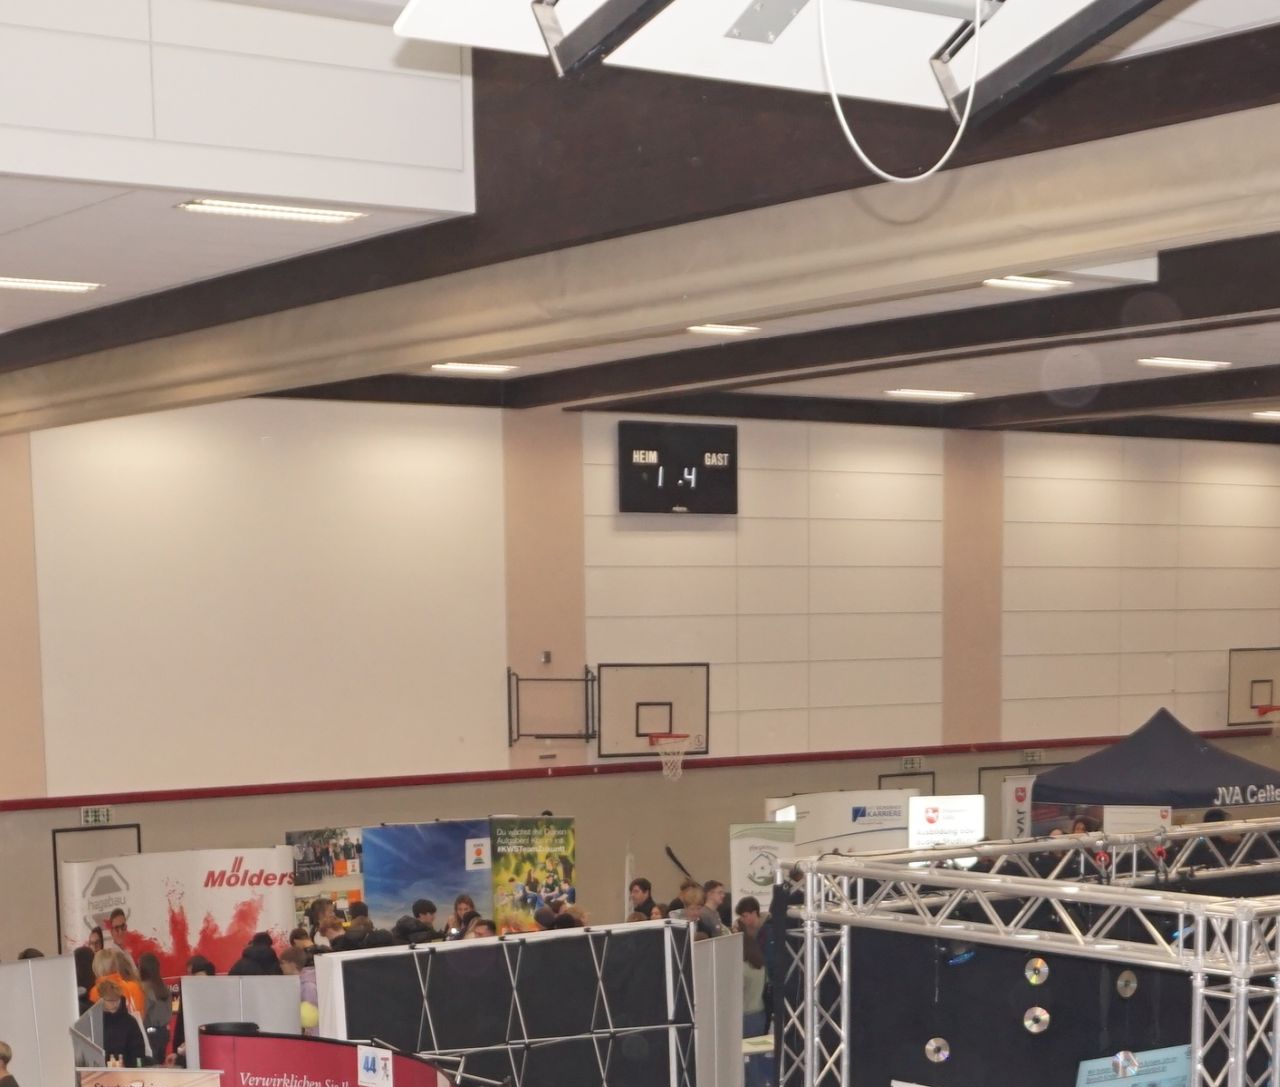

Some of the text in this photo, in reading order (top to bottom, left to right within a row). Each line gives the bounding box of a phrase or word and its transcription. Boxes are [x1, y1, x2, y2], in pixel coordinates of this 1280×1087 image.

[632, 450, 729, 466] HEIM GAST
[1213, 786, 1244, 806] JVA
[204, 856, 295, 888] Mölders
[362, 1055, 377, 1075] 44
